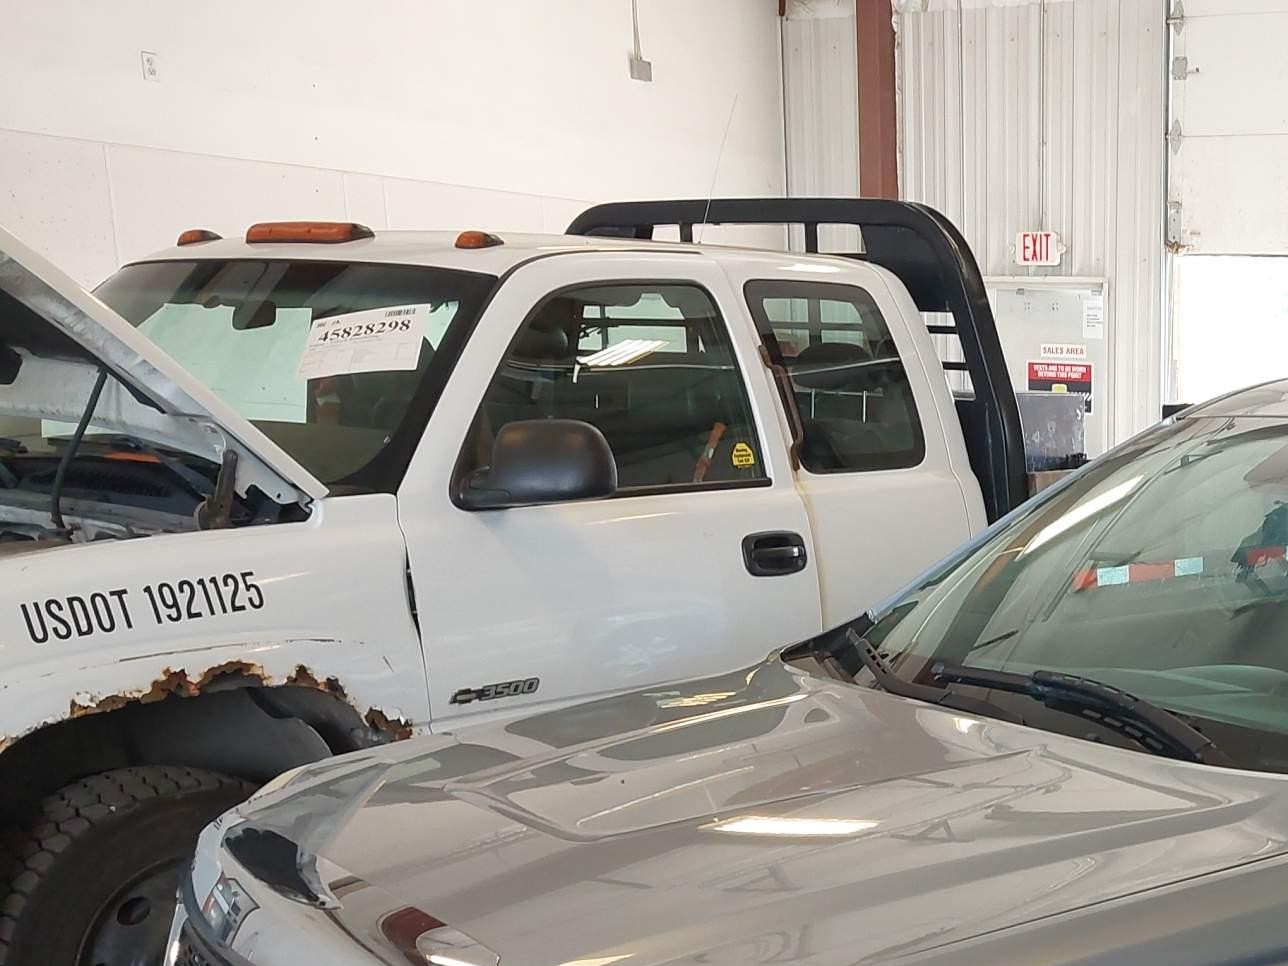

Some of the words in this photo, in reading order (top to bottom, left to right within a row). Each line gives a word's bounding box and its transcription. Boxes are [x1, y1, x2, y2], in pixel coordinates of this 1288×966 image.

[1022, 233, 1051, 262] EXIT
[318, 319, 411, 342] 45828298
[1042, 346, 1064, 355] SALES
[1065, 347, 1084, 355] AREA
[20, 588, 134, 645] USDOT
[142, 571, 265, 625] 1921125
[480, 677, 540, 701] 3500
